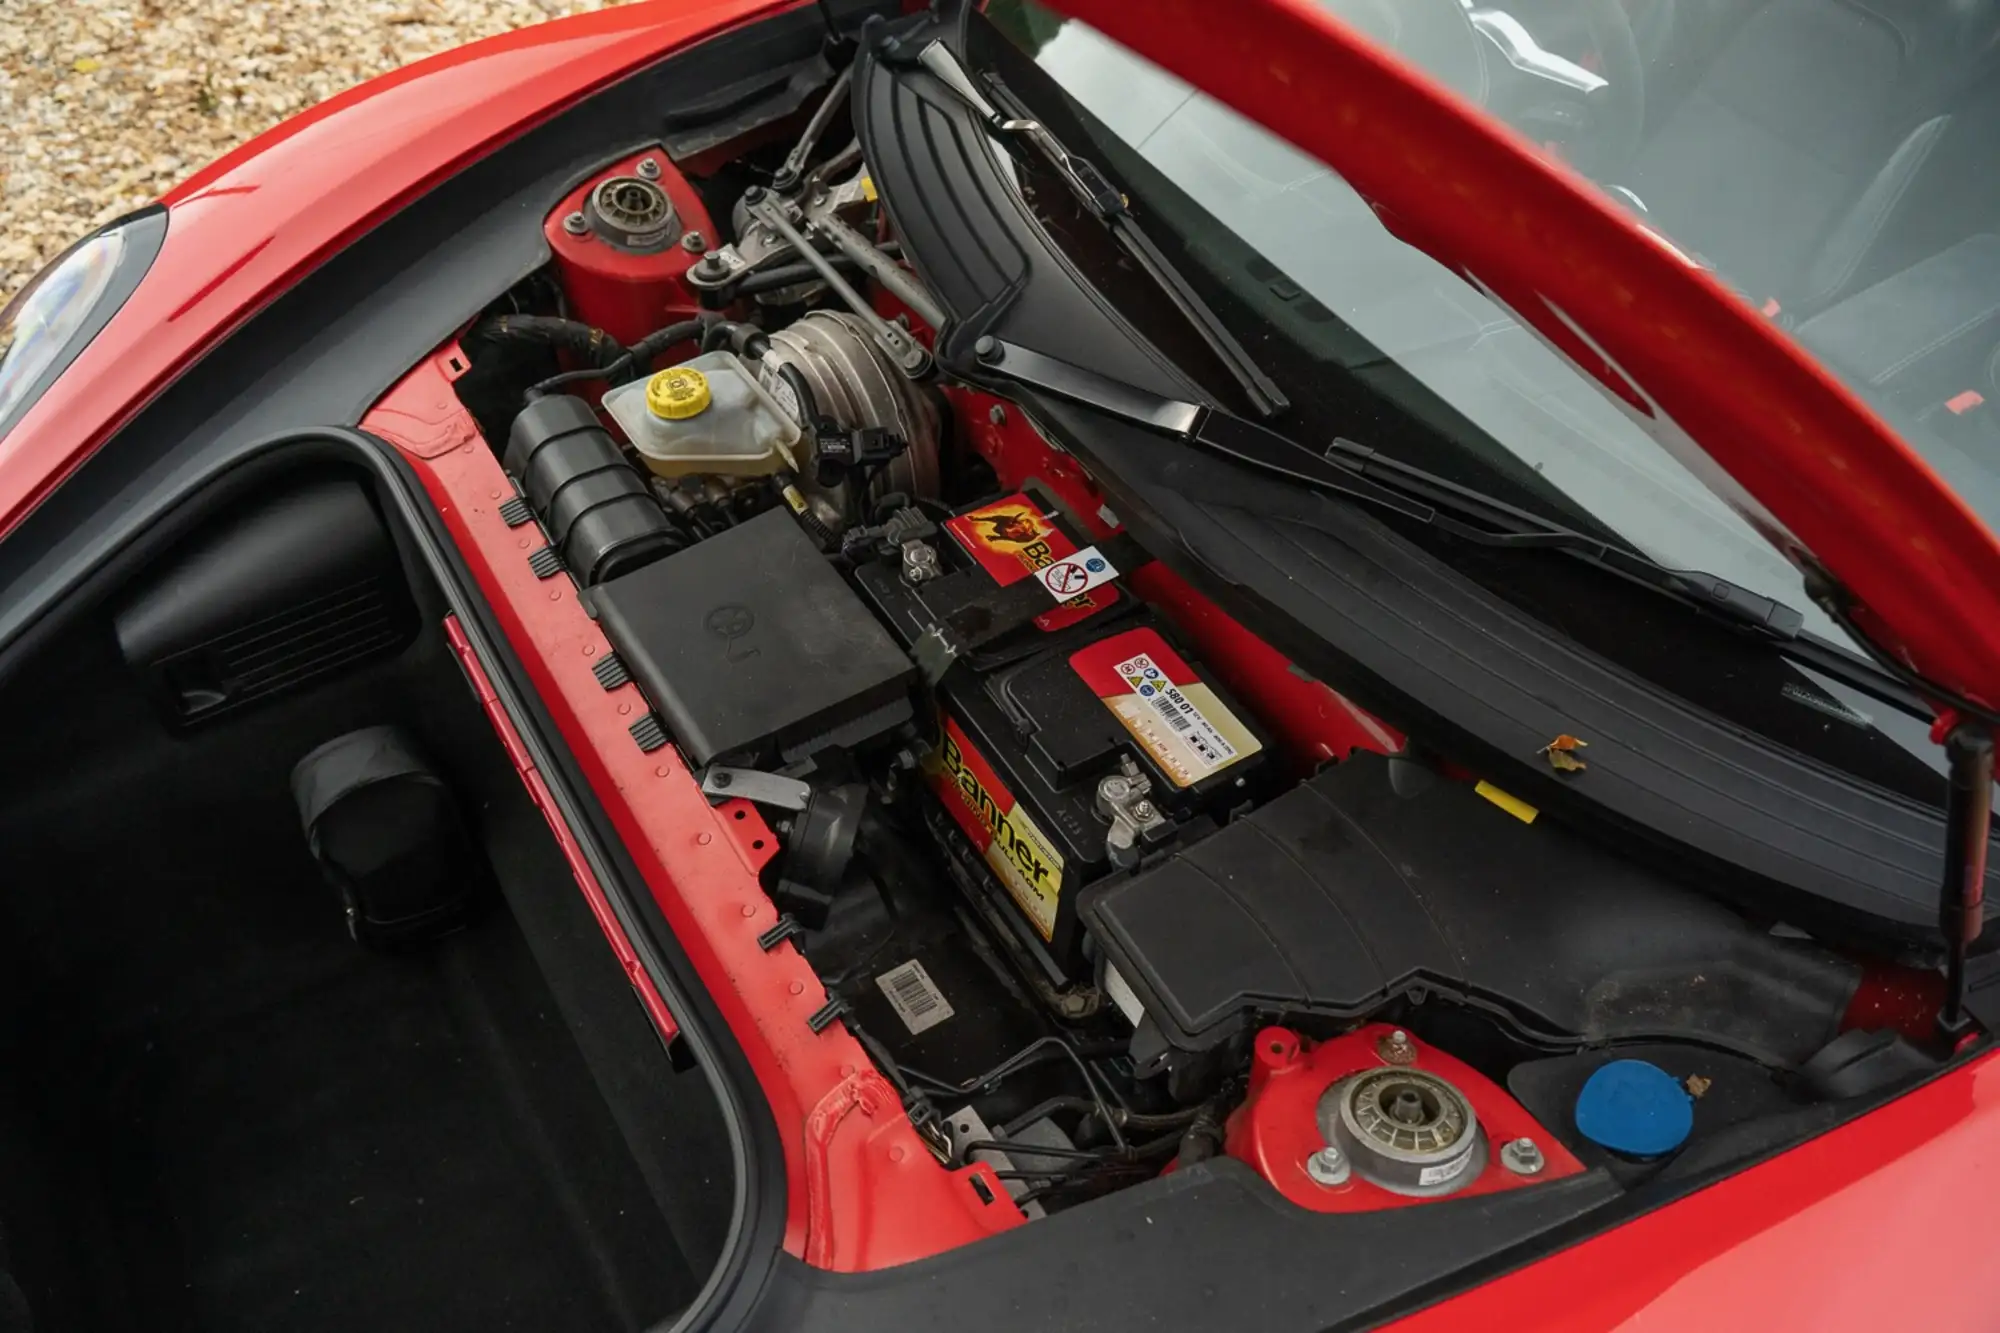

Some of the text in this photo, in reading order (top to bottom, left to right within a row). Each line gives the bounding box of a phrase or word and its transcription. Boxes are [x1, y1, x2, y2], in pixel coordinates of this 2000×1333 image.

[1180, 703, 1194, 715] 01
[942, 731, 1049, 882] Banner
[1018, 868, 1045, 901] AGM
